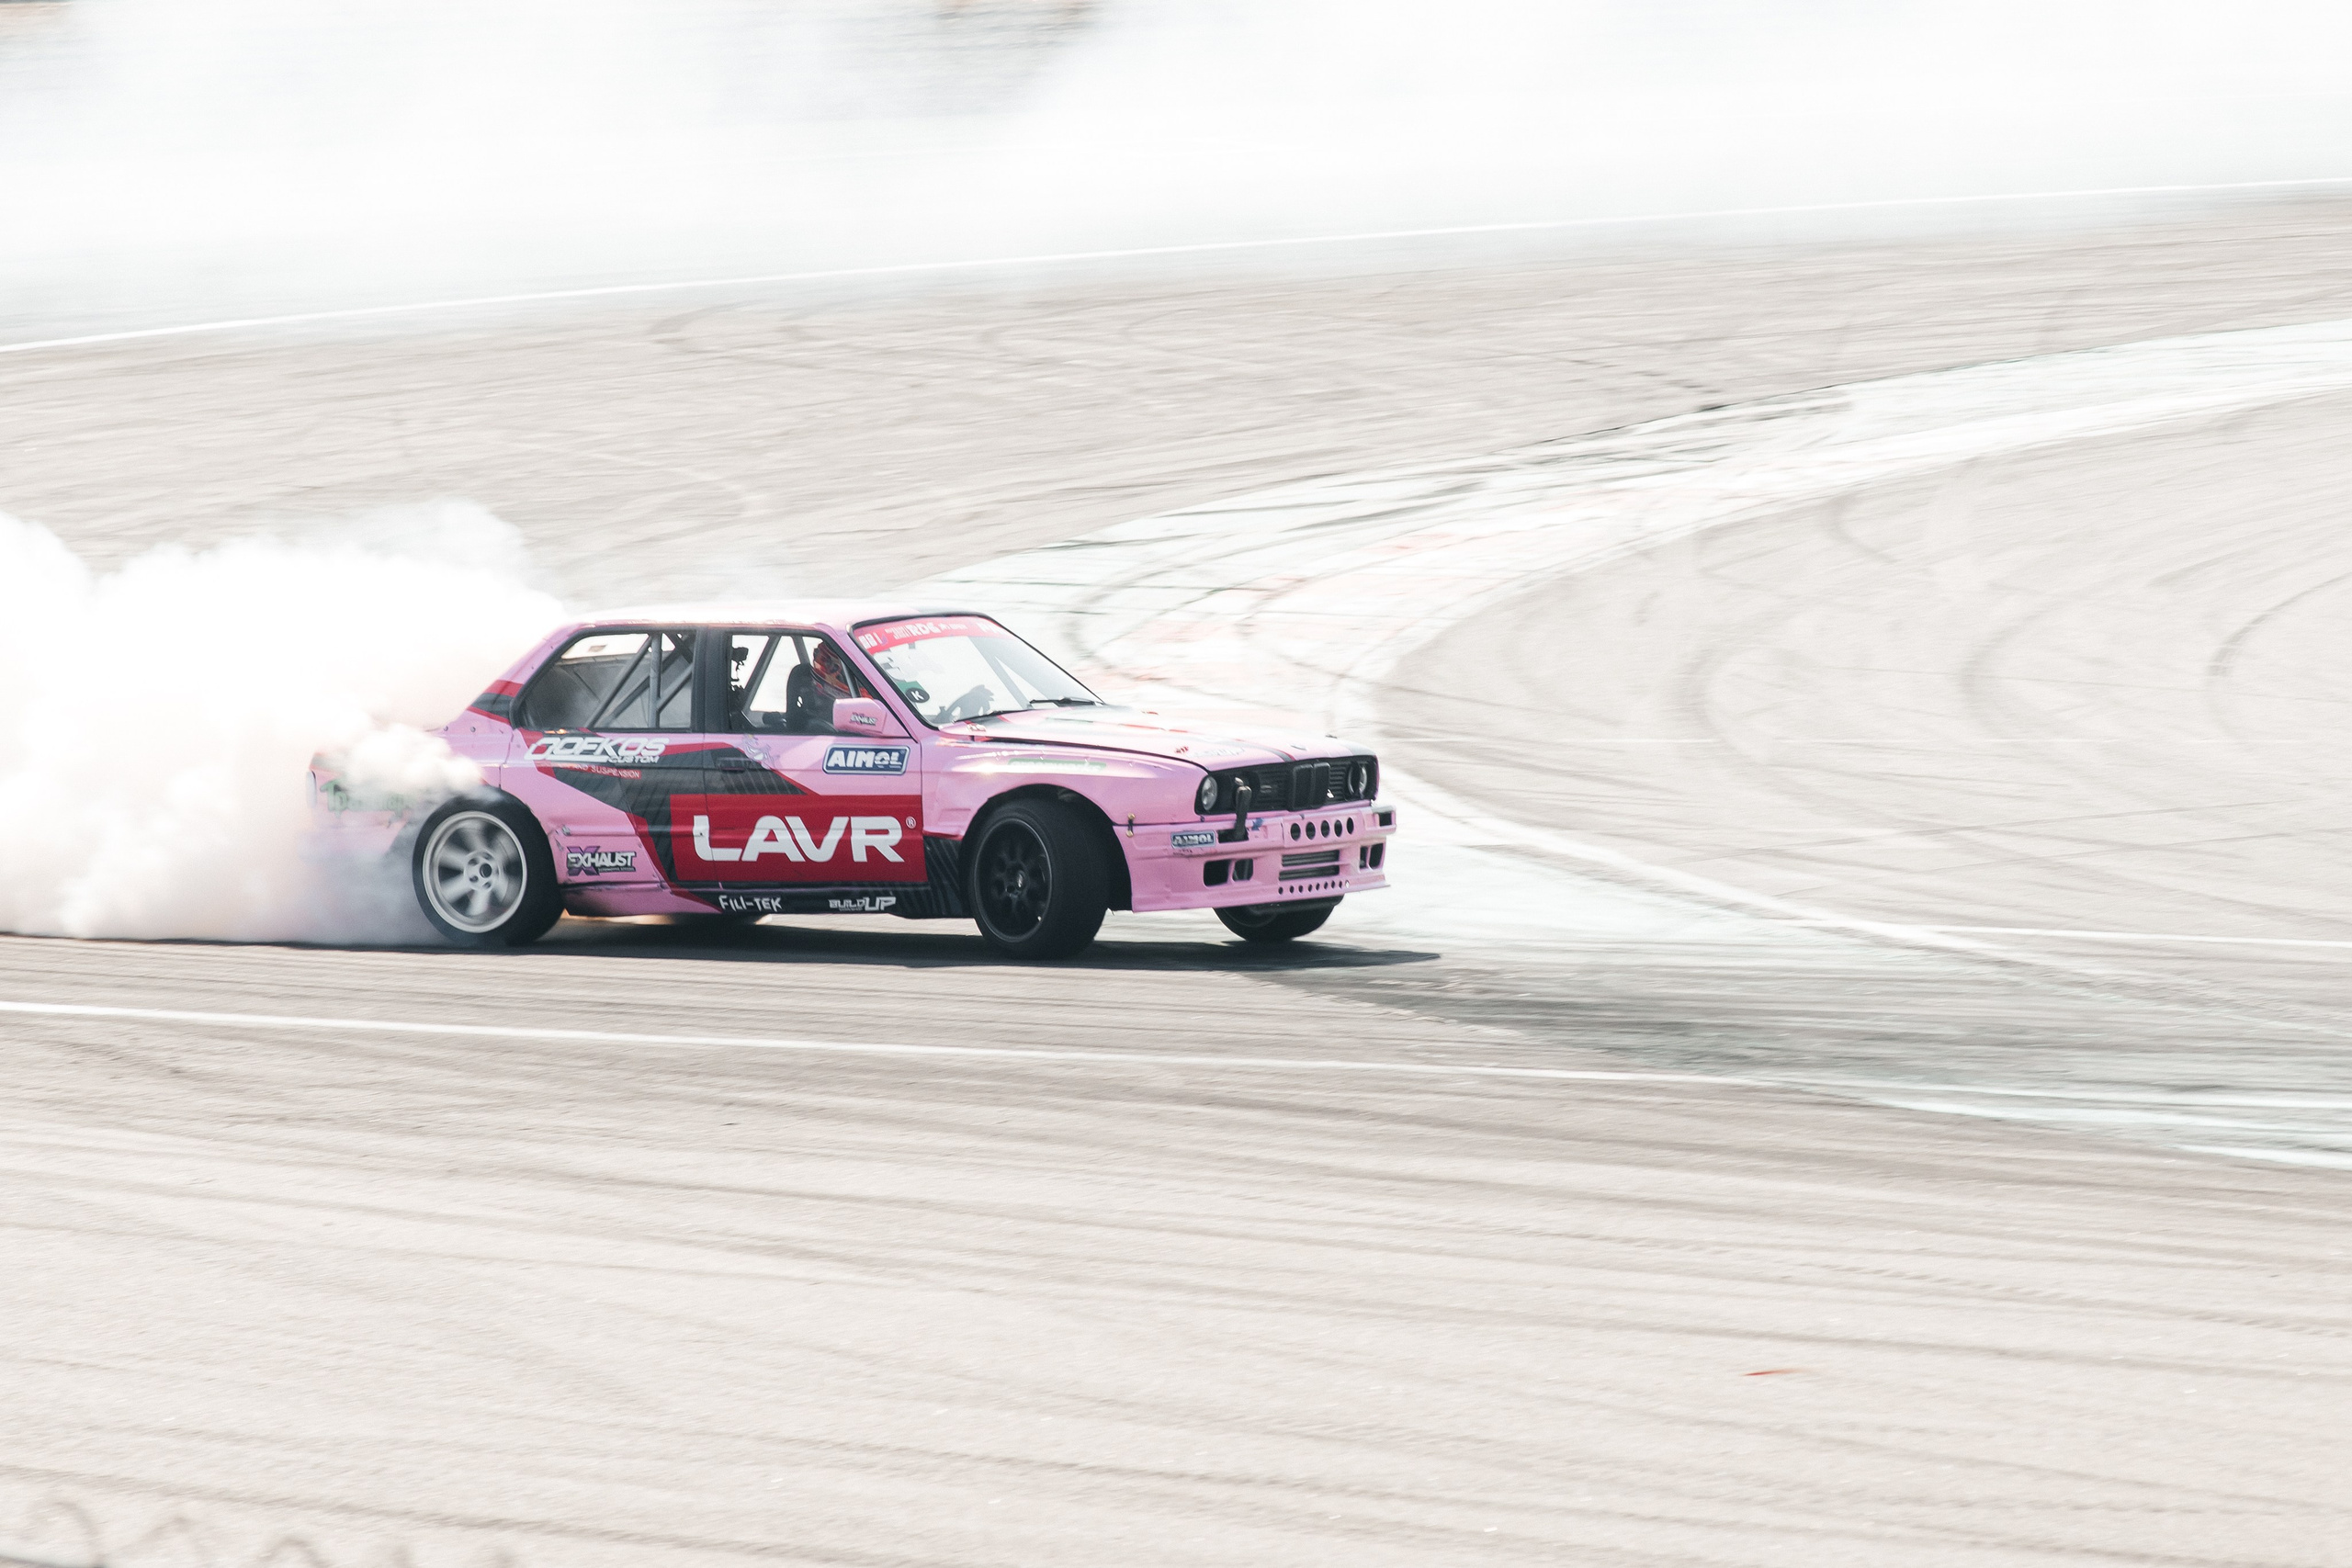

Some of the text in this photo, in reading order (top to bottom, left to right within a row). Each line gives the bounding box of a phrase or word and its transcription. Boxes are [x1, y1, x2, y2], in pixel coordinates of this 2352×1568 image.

[607, 755, 660, 764] CUSTOM
[828, 750, 902, 768] AIMOL
[591, 765, 639, 778] SUSPENSION
[567, 851, 636, 869] EXHAUST
